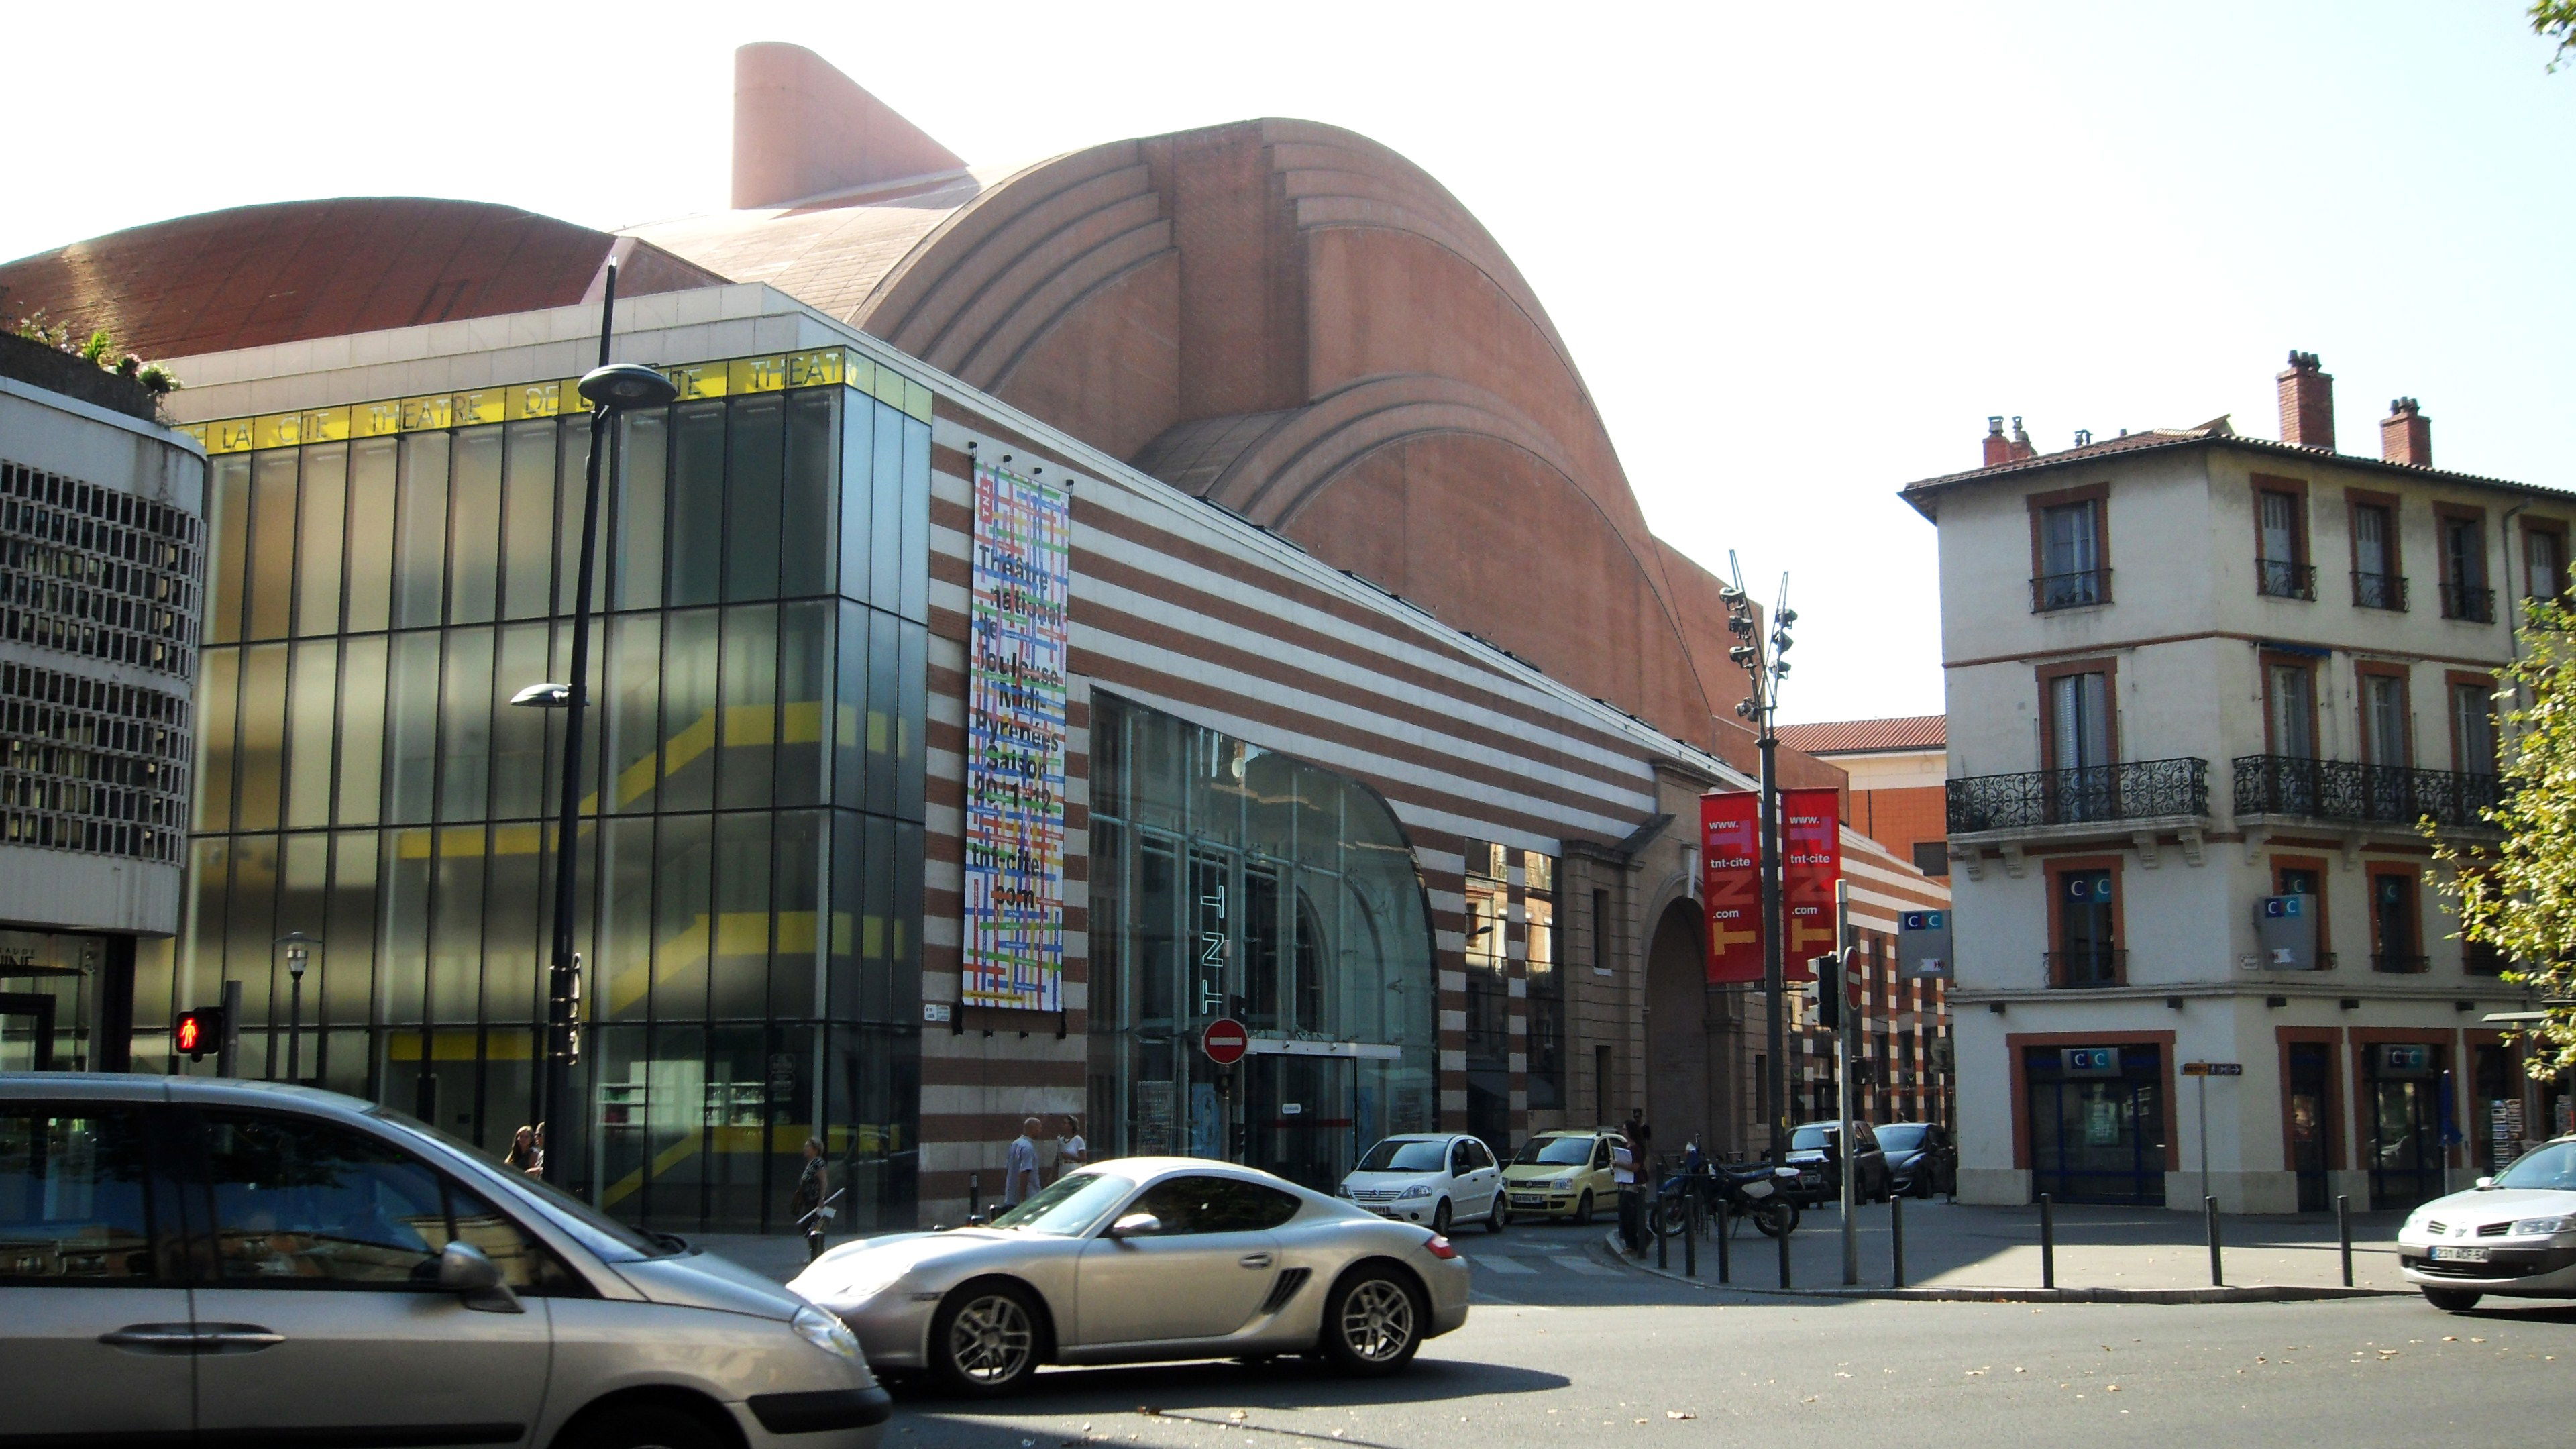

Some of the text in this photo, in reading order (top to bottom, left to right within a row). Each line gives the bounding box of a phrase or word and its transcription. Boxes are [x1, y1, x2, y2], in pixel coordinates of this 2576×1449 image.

[223, 423, 251, 449] LA
[525, 385, 559, 415] DE
[982, 485, 990, 517] TNT
[979, 544, 1048, 590] Théâtre
[990, 588, 1061, 627] national
[978, 612, 998, 639] de
[977, 641, 1058, 688] Toulouse
[987, 745, 1047, 779] Saison
[974, 775, 1051, 813] 2011-12
[1709, 820, 1738, 830] www.
[1789, 815, 1819, 824] www.
[1711, 858, 1750, 869] tnt-cite
[1790, 854, 1830, 864] tnt-cite
[996, 885, 1035, 908] com
[2267, 901, 2296, 914] CIC
[1713, 909, 1739, 918] .com
[1792, 906, 1817, 915] .com
[1908, 915, 1939, 927] CIC
[1201, 885, 1224, 1014] TNT
[2074, 1053, 2105, 1066] CIC
